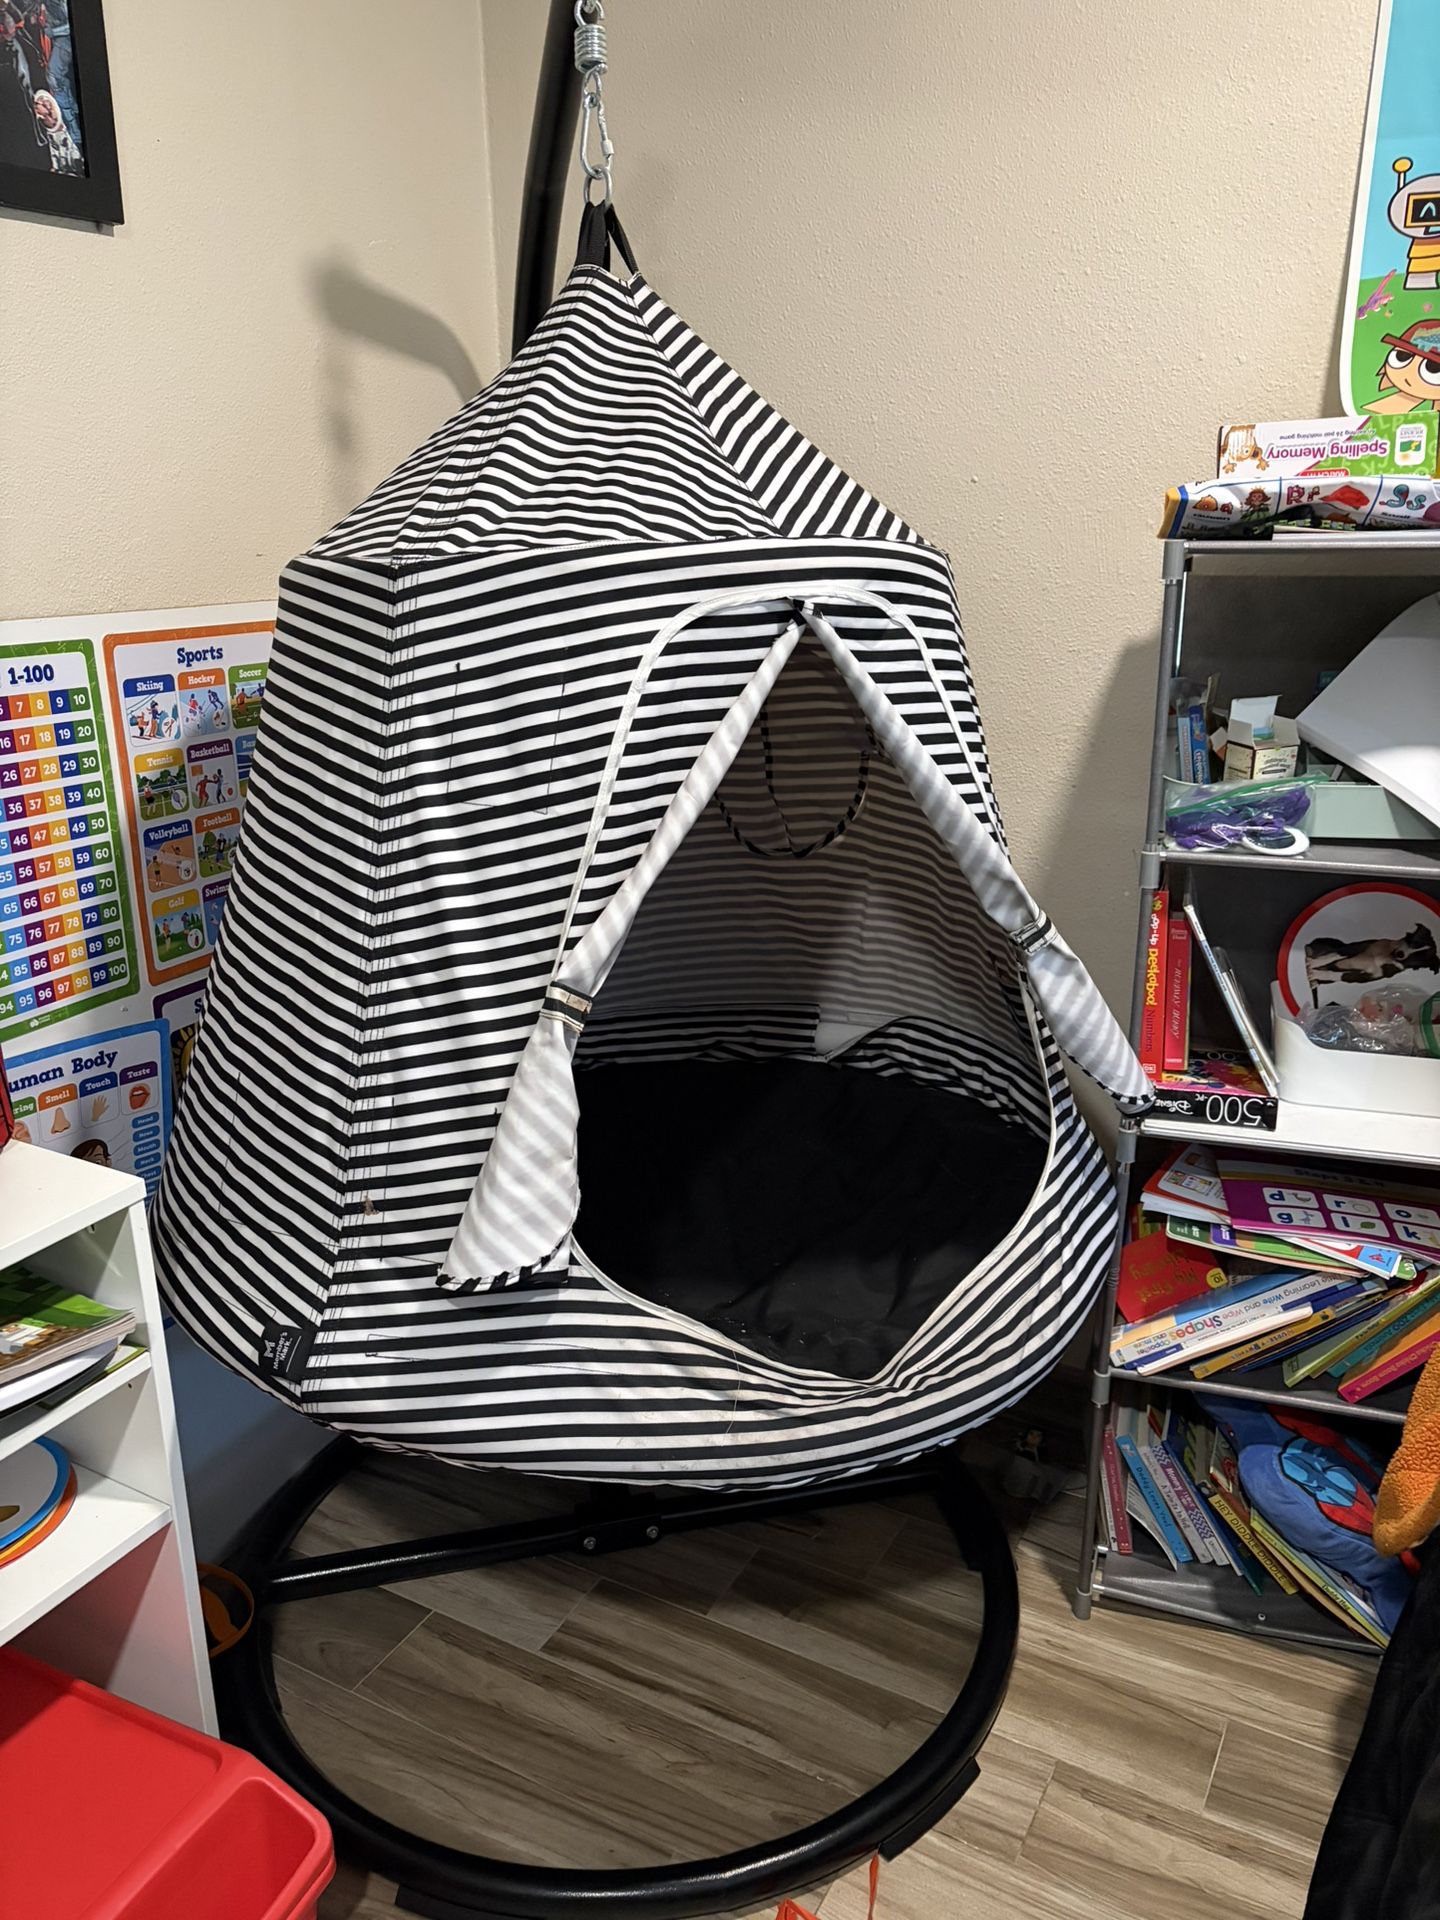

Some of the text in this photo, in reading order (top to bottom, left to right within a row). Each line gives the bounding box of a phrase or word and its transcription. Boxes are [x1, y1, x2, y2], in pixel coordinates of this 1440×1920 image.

[1296, 431, 1323, 441] matching
[1266, 440, 1388, 461] Spelling Memory
[176, 646, 224, 667] Sports
[8, 664, 54, 685] 1-100
[187, 674, 216, 686] Hockey
[239, 668, 262, 679] Soccer
[136, 681, 164, 693] Skiing
[16, 701, 23, 713] 7
[36, 699, 44, 710] 8
[56, 697, 64, 707] 9
[73, 693, 86, 705] 10
[19, 734, 30, 746] 17
[39, 731, 51, 743] 18
[59, 728, 71, 740] 19
[77, 726, 91, 738] 20
[190, 743, 230, 759] Basketball
[3, 756, 97, 782] 26 27 28 29 30
[146, 755, 174, 767] Tennis
[8, 787, 101, 814] 36 37 38 39 40
[203, 813, 232, 827] Football
[0, 818, 105, 850] 5 46 47 48 49 50
[148, 823, 189, 841] Volleyball
[18, 866, 33, 878] 56
[39, 861, 51, 873] 57
[57, 857, 72, 868] 58
[76, 852, 90, 864] 59
[95, 848, 109, 860] 60
[3, 878, 113, 914] 65 66 67 68 69 70
[168, 896, 184, 908] Golf
[8, 907, 117, 946] 75 76 77 78 79 80
[0, 936, 121, 981] 4 85 86 87 88 89 90
[1145, 948, 1159, 1006] peekaboo!
[0, 964, 126, 1014] 94 95 96 97 98 99 100
[1145, 1009, 1157, 1053] Numbers
[8, 1051, 118, 1093] uman Body
[127, 1067, 151, 1079] Taste
[85, 1078, 111, 1091] Touch
[45, 1090, 70, 1104] Smell
[1154, 1097, 1194, 1116] Disne
[1269, 1190, 1286, 1201] d
[1334, 1199, 1346, 1209] r
[1277, 1211, 1294, 1224] g
[1395, 1208, 1412, 1219] o
[1402, 1225, 1422, 1240] k
[1261, 1292, 1284, 1306] Write
[1283, 1281, 1319, 1300] Learning
[1222, 1304, 1244, 1321] Wipe
[1244, 1301, 1261, 1315] and
[1175, 1312, 1223, 1339] Shapes
[273, 1332, 288, 1370] Member's
[279, 1340, 292, 1361] Mark
[1136, 1466, 1150, 1492] Daddy
[1148, 1490, 1161, 1509] Loves
[1166, 1467, 1183, 1491] Mommy
[1215, 1500, 1233, 1517] HEY
[1230, 1515, 1259, 1550] DIDDLE
[1257, 1549, 1286, 1581] DIDDLE
